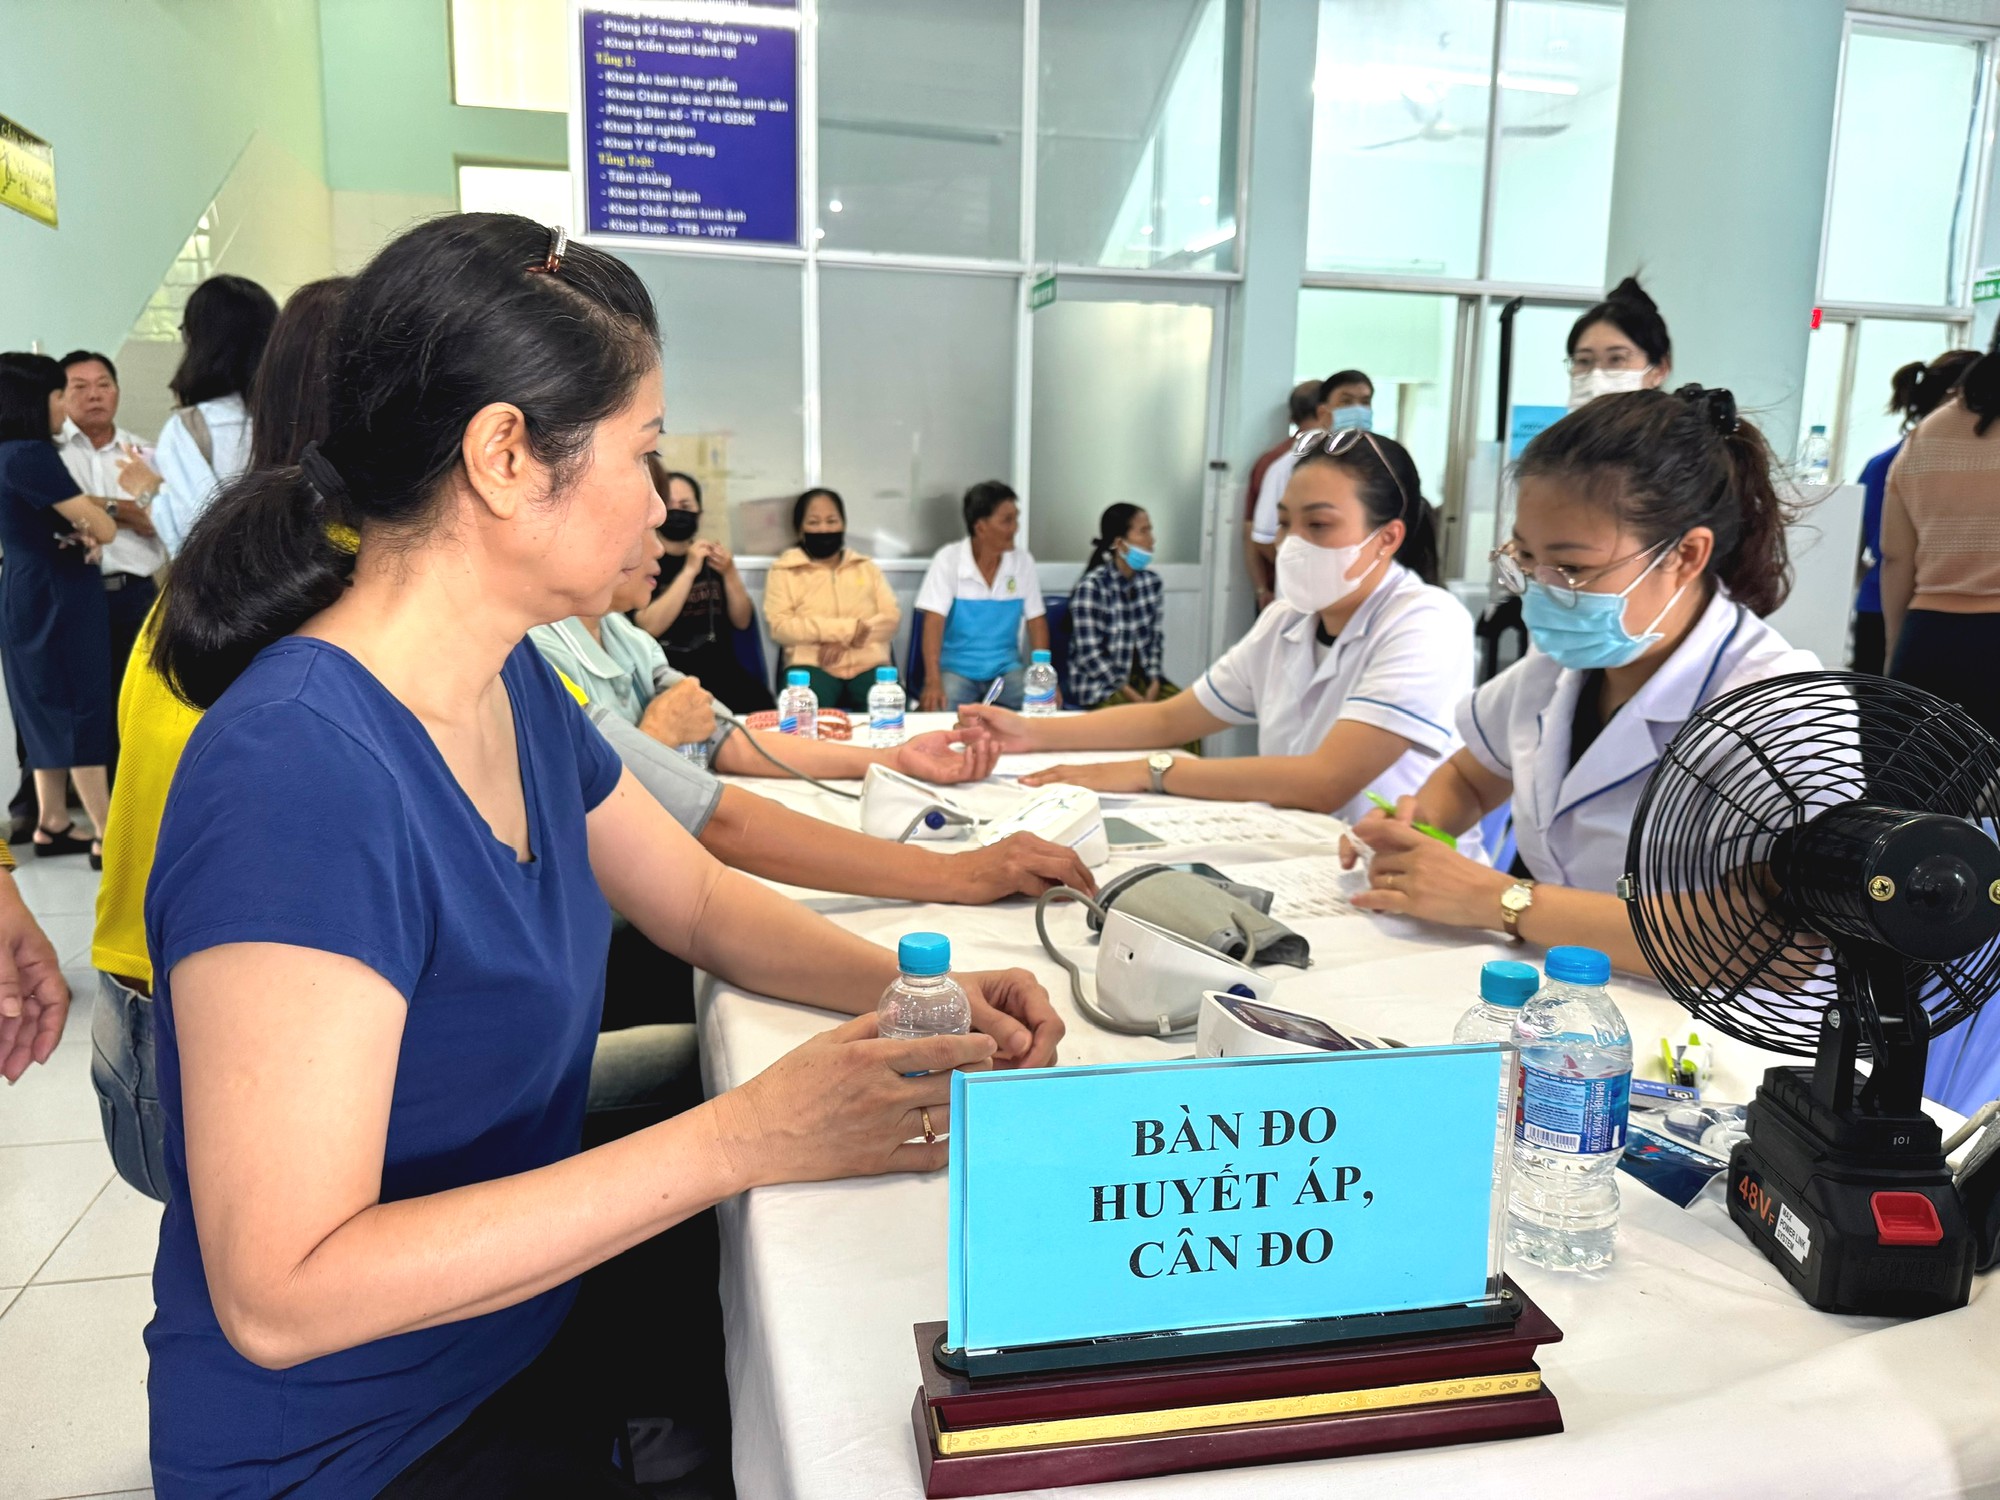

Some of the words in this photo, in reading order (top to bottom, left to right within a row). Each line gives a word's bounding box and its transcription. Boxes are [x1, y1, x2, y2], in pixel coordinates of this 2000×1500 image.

[636, 72, 652, 85] An
[690, 108, 706, 122] TT
[634, 138, 643, 151] Y
[1131, 1104, 1244, 1157] BÀN
[1258, 1106, 1337, 1147] ĐO
[1089, 1163, 1278, 1222] HUYẾT
[1292, 1156, 1374, 1208] ÁP,
[1738, 1175, 1772, 1220] 48V
[1782, 1207, 1793, 1223] MAX
[1776, 1228, 1795, 1251] SYSTEM
[1779, 1218, 1796, 1240] POWER
[1795, 1234, 1807, 1250] LINK
[1129, 1227, 1242, 1278] CÂN
[1257, 1228, 1334, 1268] ĐO
